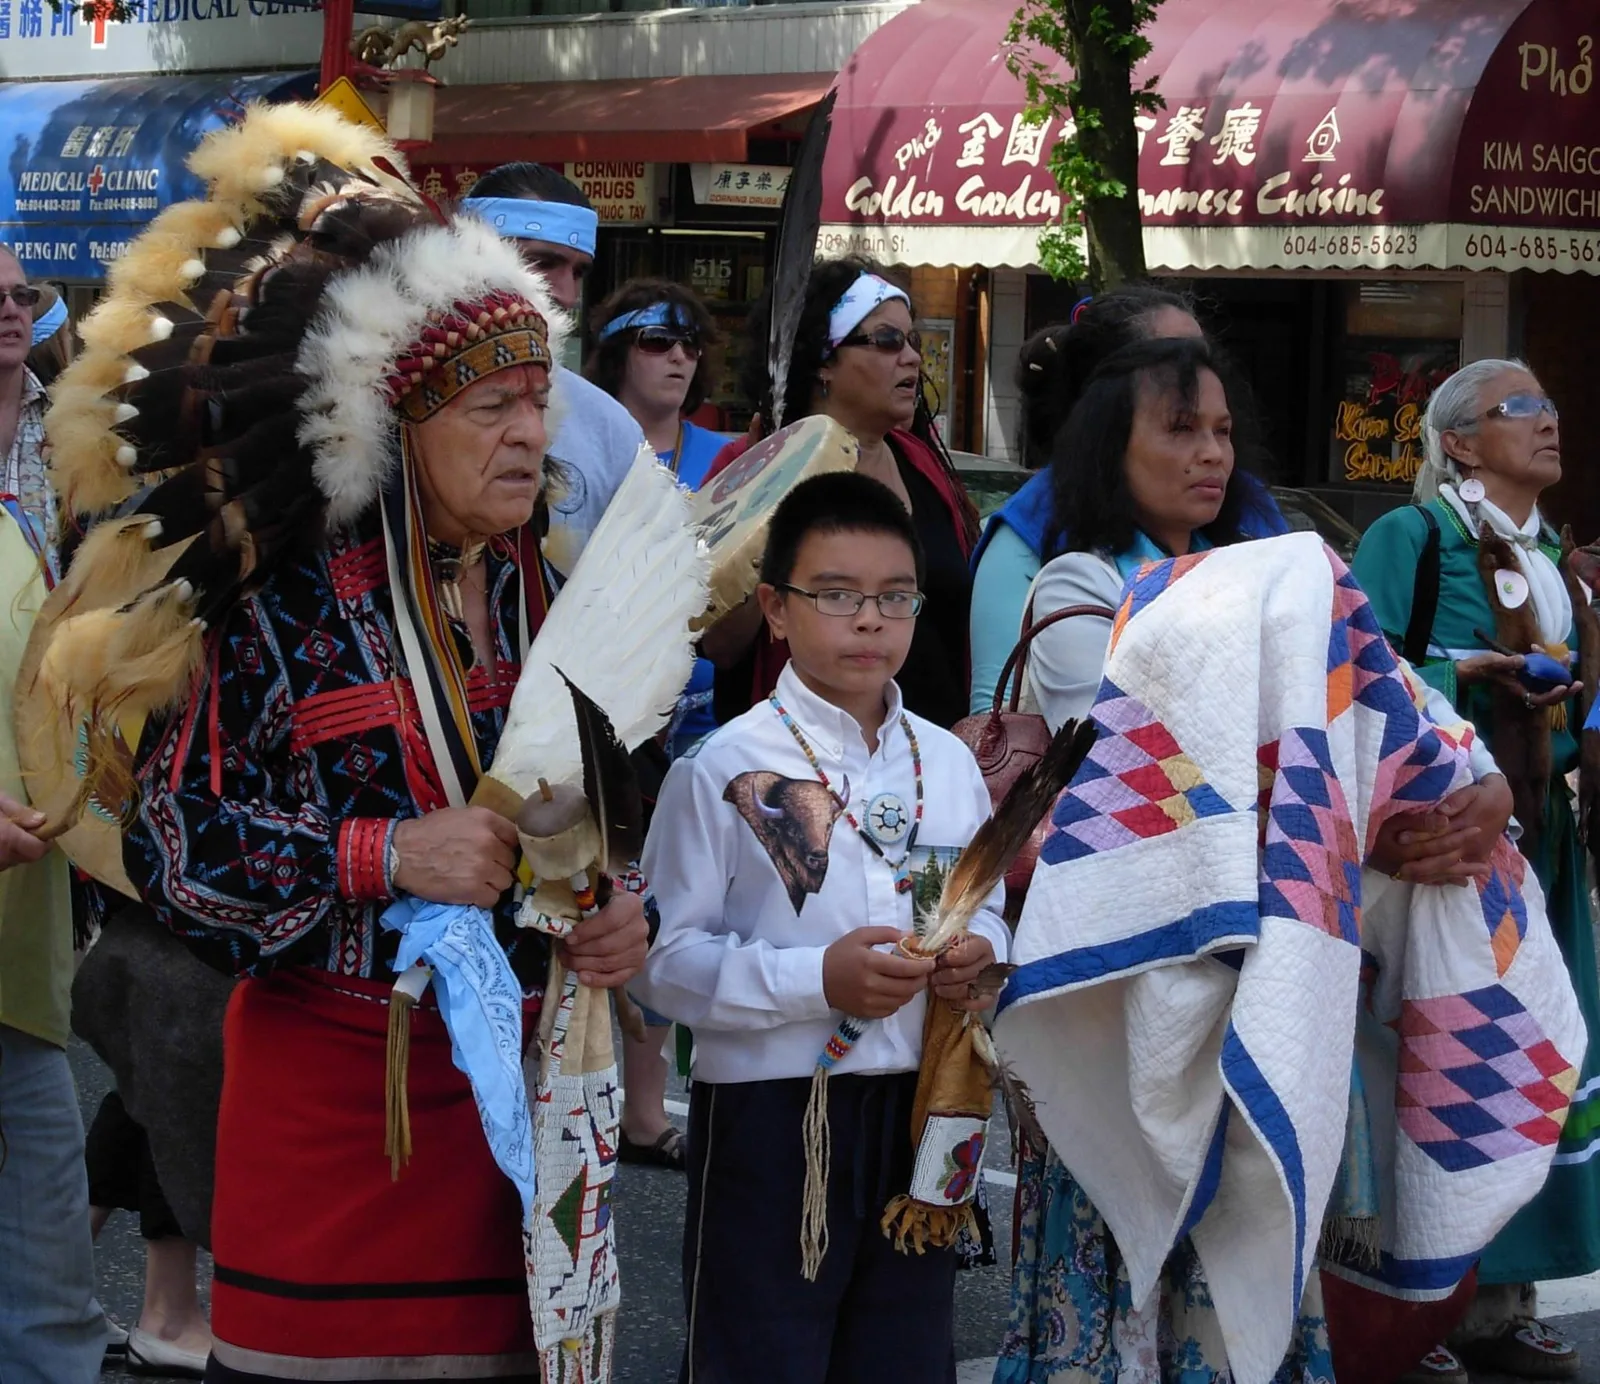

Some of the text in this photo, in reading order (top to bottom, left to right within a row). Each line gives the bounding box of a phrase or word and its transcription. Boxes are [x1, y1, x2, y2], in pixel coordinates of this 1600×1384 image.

[1518, 35, 1593, 97] Phở
[60, 124, 141, 158] 醫務所
[956, 102, 1262, 168] 金園餐廳
[1483, 141, 1523, 172] KIM
[19, 168, 159, 192] MEDICAL CLINIC
[574, 162, 645, 178] CORNING
[582, 181, 635, 199] DRUGS
[845, 174, 944, 219] Golden
[955, 174, 1060, 219] Garden
[1256, 170, 1385, 217] Cuisine
[1470, 184, 1600, 218] SANDWICH
[54, 242, 77, 260] INC
[847, 233, 886, 252] Main
[892, 234, 910, 253] St.
[1283, 235, 1418, 255] 604-685-5623
[692, 258, 732, 278] 515
